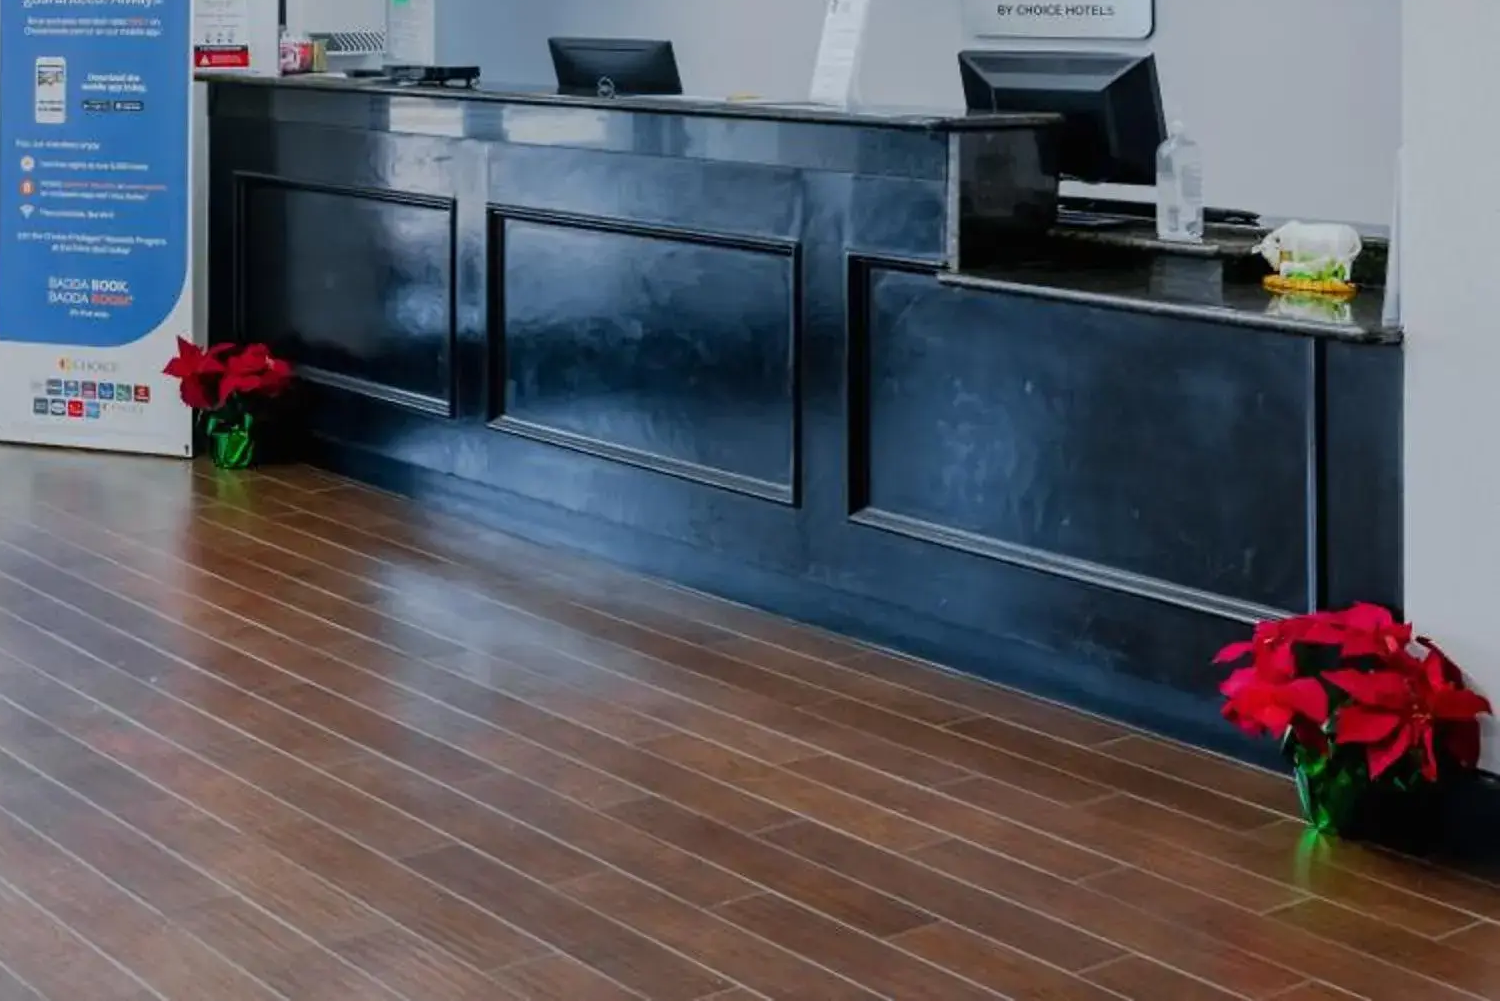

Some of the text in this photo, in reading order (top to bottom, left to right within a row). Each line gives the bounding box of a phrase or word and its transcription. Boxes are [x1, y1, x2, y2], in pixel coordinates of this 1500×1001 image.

[997, 4, 1116, 16] BY CHOICE HOTELS
